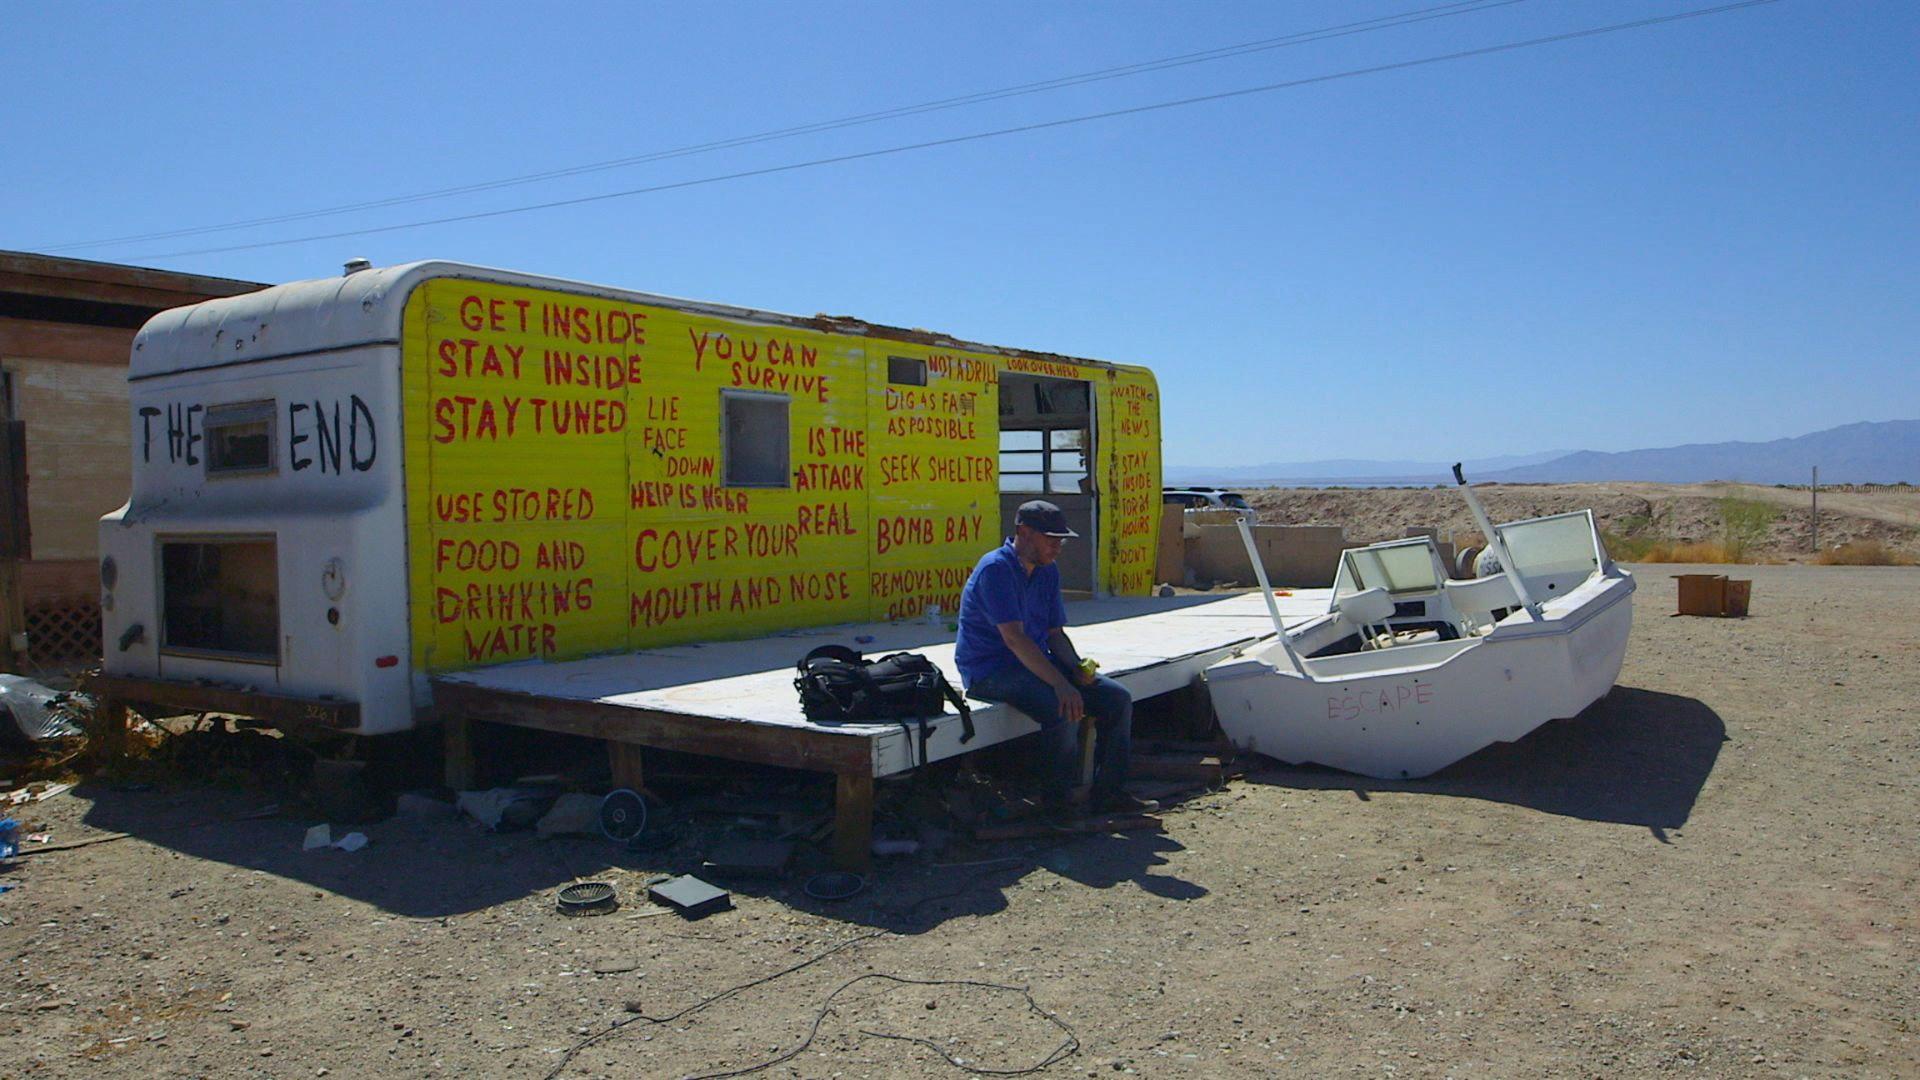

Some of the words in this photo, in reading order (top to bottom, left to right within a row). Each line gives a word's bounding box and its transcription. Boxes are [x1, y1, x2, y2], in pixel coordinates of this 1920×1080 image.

[460, 296, 530, 332] GET
[543, 303, 647, 345] INSIDE
[690, 327, 757, 371] YOU
[767, 339, 817, 368] CAN
[438, 339, 524, 379] STAY
[544, 350, 642, 390] INSIDE
[929, 355, 952, 378] NOT
[957, 358, 963, 381] A
[966, 359, 998, 384] DRILL
[731, 361, 829, 403] SURVIVE
[1112, 384, 1146, 400] WATCH
[649, 397, 680, 421] LIE
[886, 388, 914, 411] DIG
[920, 392, 935, 411] AS
[1127, 400, 1140, 416] THE
[139, 402, 203, 466] THE
[290, 394, 377, 475] END
[434, 396, 522, 444] STAY
[529, 398, 626, 434] TUNED
[888, 417, 905, 437] AS
[910, 418, 976, 440] POSSIBLE
[1122, 418, 1149, 438] NEWS
[644, 428, 688, 450] FACE
[808, 427, 825, 457] IS
[830, 427, 865, 457] THE
[667, 456, 714, 478] DOWN
[880, 455, 920, 486] SEEK
[929, 455, 993, 482] SHELTER
[1123, 451, 1147, 474] STAY
[796, 464, 863, 492] ATTACK
[1123, 473, 1151, 491] INSIDE
[437, 492, 484, 522] USE
[492, 487, 594, 522] STORED
[631, 480, 674, 510] HELP
[679, 483, 696, 509] IS
[798, 502, 857, 535] REAL
[635, 526, 738, 572] COVER
[744, 522, 799, 557] YOUR
[877, 515, 933, 554] BOMB
[945, 515, 982, 543] BAY
[437, 539, 520, 573] FOOD
[536, 540, 585, 571] AND
[871, 569, 931, 597] REMOVE
[1122, 572, 1142, 592] RUN
[437, 578, 593, 624] DRINKING
[630, 578, 721, 628] MOUTH
[729, 576, 781, 613] AND
[789, 571, 850, 602] NOSE
[464, 623, 556, 661] WATER
[1327, 683, 1434, 720] ESCAPE
